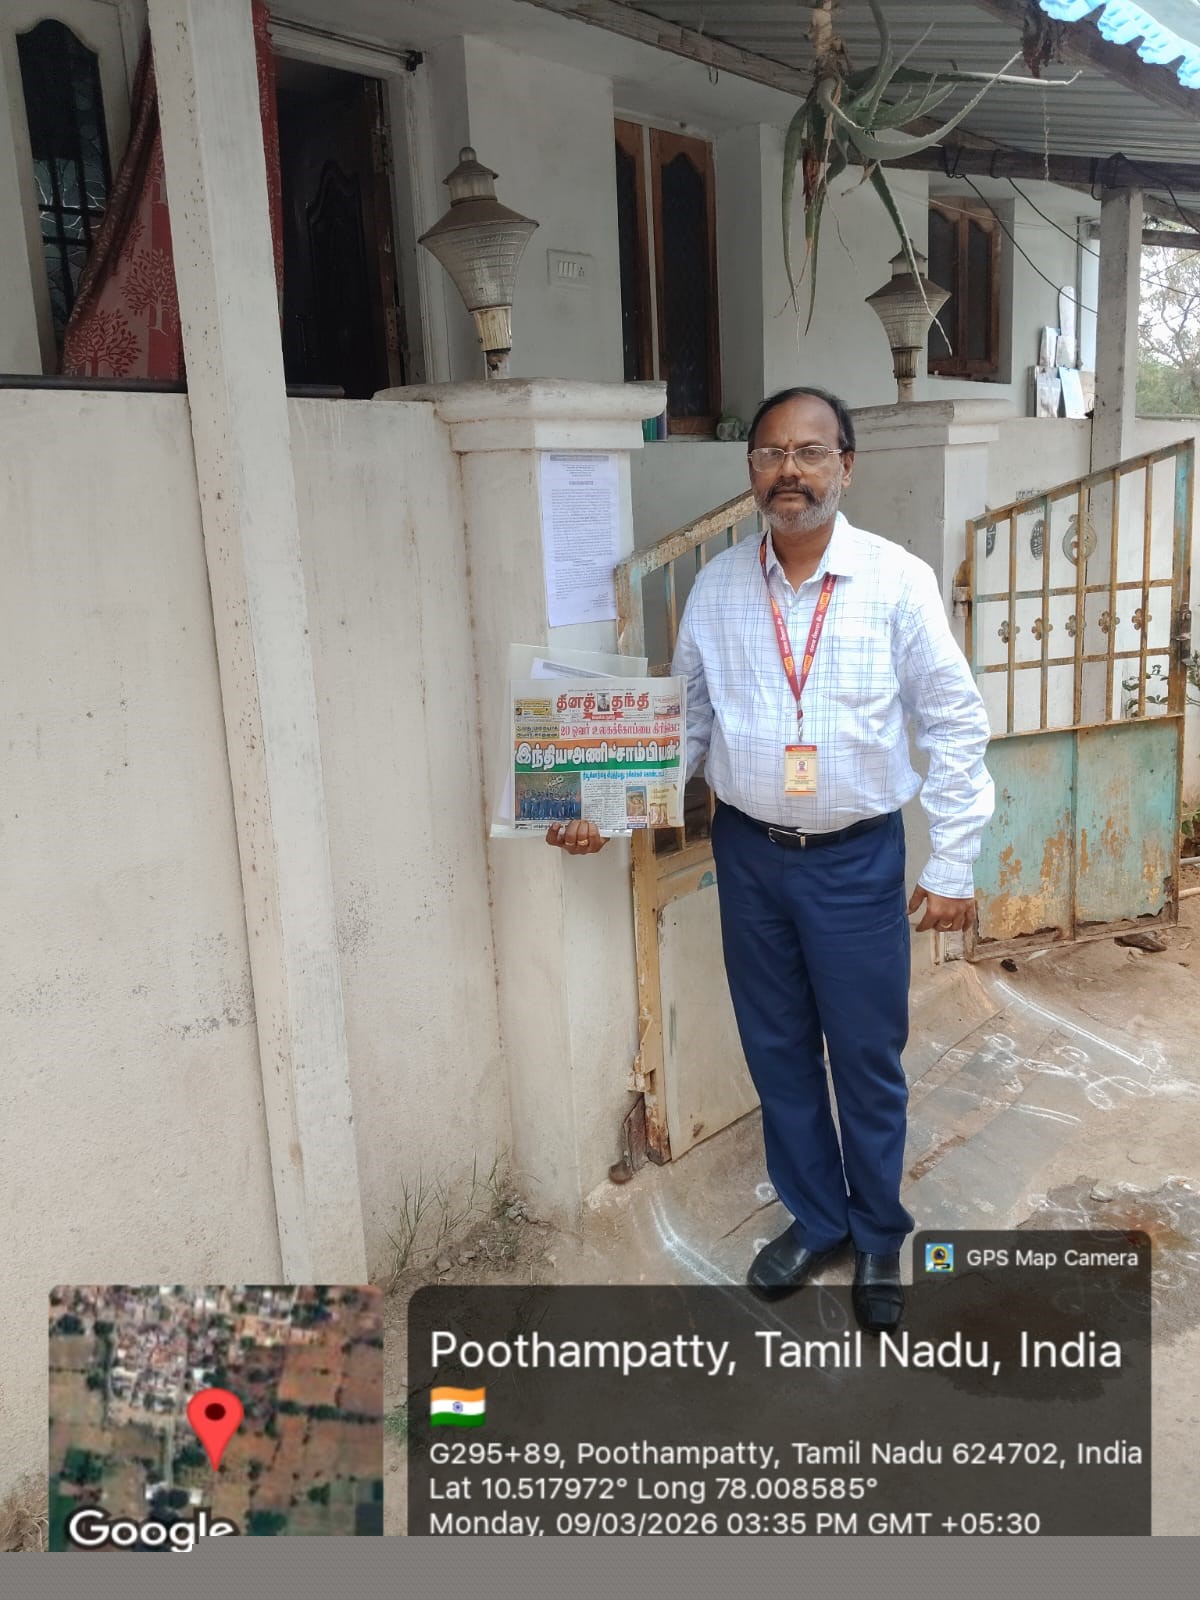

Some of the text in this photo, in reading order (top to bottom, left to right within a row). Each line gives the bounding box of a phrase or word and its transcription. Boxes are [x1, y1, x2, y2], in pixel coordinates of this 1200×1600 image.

[556, 692, 596, 713] தினத்
[611, 691, 650, 712] தந்தி
[515, 742, 568, 770] இந்திய
[573, 741, 608, 765] அணி
